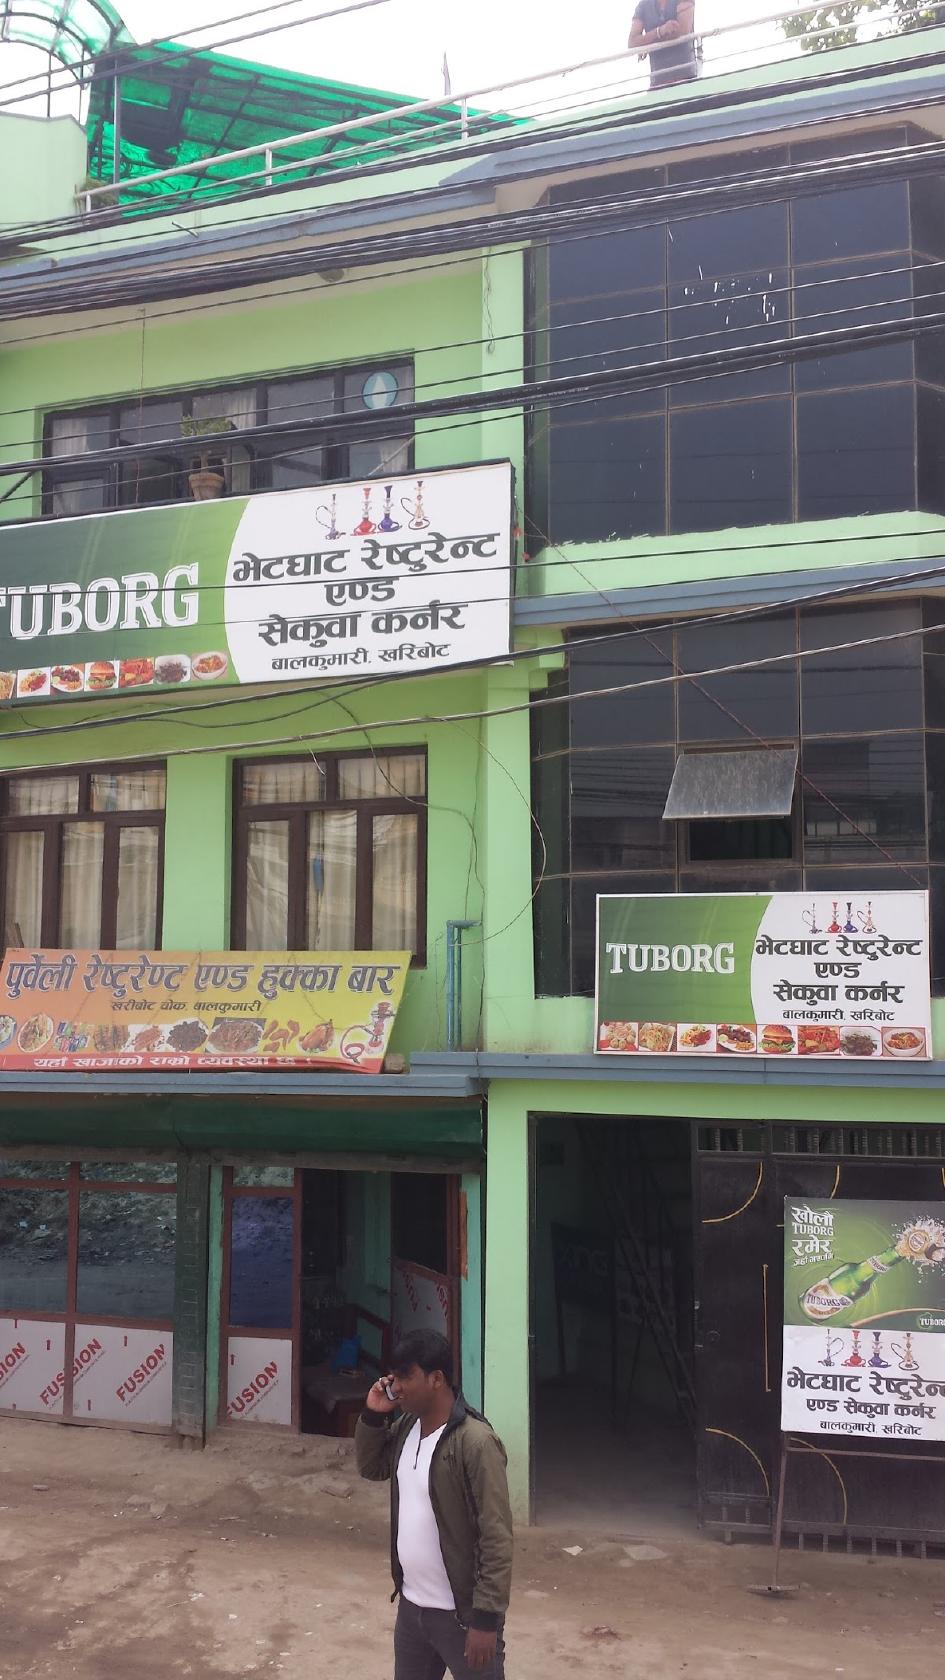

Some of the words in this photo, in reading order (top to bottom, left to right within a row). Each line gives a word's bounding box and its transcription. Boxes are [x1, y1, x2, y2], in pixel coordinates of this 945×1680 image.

[232, 549, 351, 582] भेटघाट
[324, 575, 400, 606] एण्ड
[258, 612, 362, 648] सेकुवा
[371, 600, 469, 635] कर्नर
[378, 640, 451, 664] खरिबोट
[755, 934, 830, 956] भेटघाट
[605, 942, 735, 974] TUBORG
[813, 962, 863, 979] एण्ड
[193, 963, 255, 993] एण्ड
[257, 963, 343, 1000] हुक्का
[347, 964, 401, 996] बार
[773, 979, 839, 1006] सेकुवा
[844, 980, 906, 1004] कर्नर
[193, 999, 262, 1014] बालकुमारी
[850, 1009, 896, 1022] खरिबोट
[791, 1222, 834, 1236] TUBORG
[791, 1234, 834, 1257] रमेर
[919, 1318, 945, 1327] TUBOR
[0, 1342, 26, 1380] ION
[116, 1343, 165, 1402] FUSION
[786, 1366, 862, 1393] भेटघाट
[868, 1371, 945, 1400] रेष्टुरेन्
[806, 1398, 840, 1412] एण्ड
[843, 1397, 890, 1419] सेकुवा
[893, 1402, 937, 1419] कर्नर
